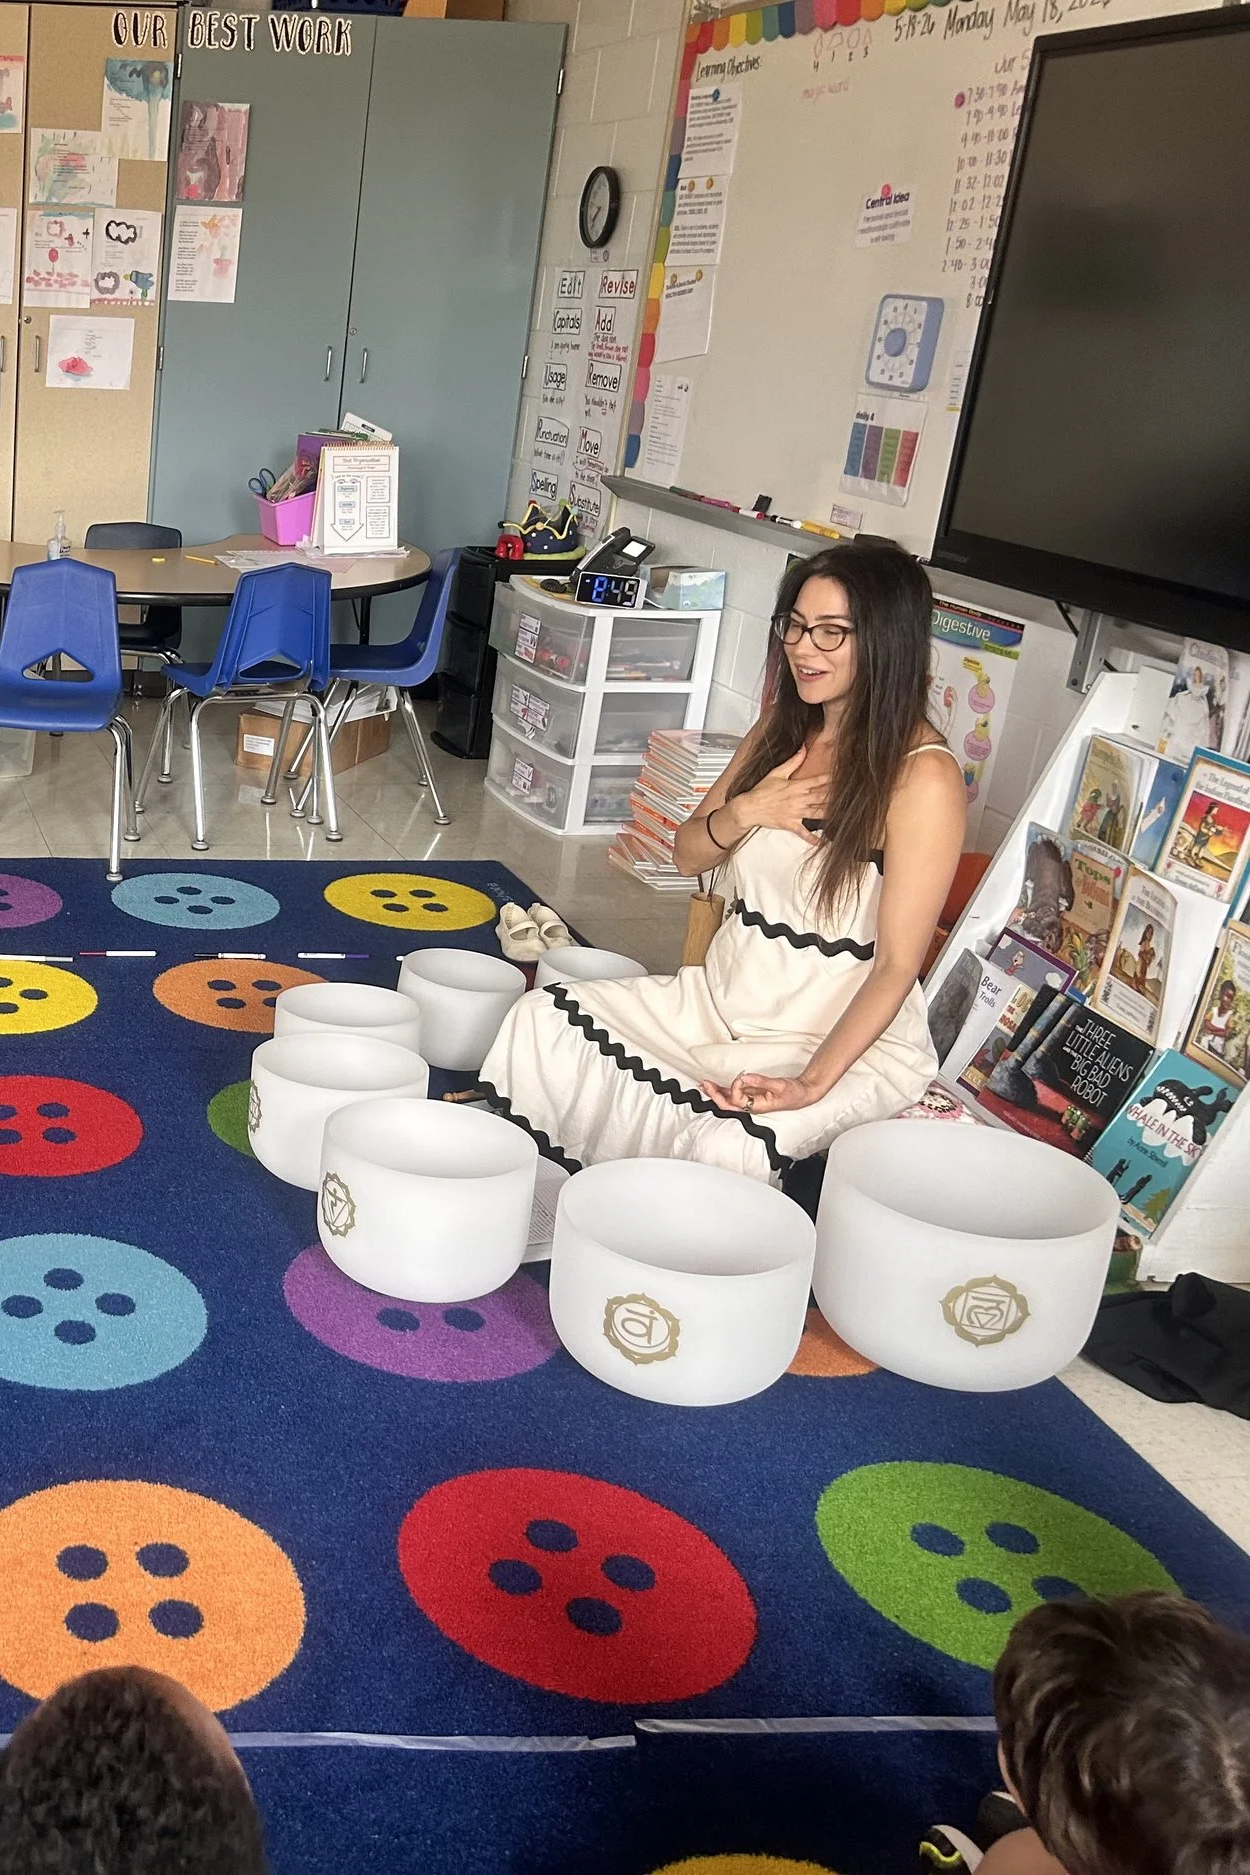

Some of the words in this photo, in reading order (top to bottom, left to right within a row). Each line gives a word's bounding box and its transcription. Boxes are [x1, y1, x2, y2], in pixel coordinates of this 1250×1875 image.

[112, 11, 167, 48] OUR
[189, 11, 259, 50] BEST
[269, 14, 352, 55] WORK
[943, 1, 995, 41] Monday
[1003, 0, 1036, 36] May
[695, 60, 726, 84] Learning
[813, 60, 819, 72] 4
[865, 194, 893, 209] Central
[893, 191, 910, 204] Idea
[560, 274, 582, 295] Edit
[600, 275, 635, 295] Revise
[553, 310, 581, 332] Capitals
[594, 308, 612, 332] Add
[544, 364, 566, 388] Usage
[588, 362, 618, 389] Remove
[536, 418, 567, 443] Punctuation
[580, 429, 599, 455] Move
[531, 472, 556, 499] Spelling
[569, 484, 599, 514] Substitute
[592, 576, 638, 607] 8:49
[933, 609, 991, 641] Digestive
[1075, 859, 1110, 885] Tops
[980, 976, 1002, 996] Bear
[979, 991, 996, 1008] Trolls
[1082, 1018, 1116, 1050] THREE
[1065, 1030, 1101, 1061] LITTLE
[1094, 1050, 1134, 1082] ALIENS
[1070, 1054, 1092, 1077] BIG
[1087, 1065, 1111, 1089] BAD
[1070, 1075, 1108, 1107] ROBOT
[1154, 1121, 1170, 1138] IN
[1166, 1129, 1188, 1150] THE
